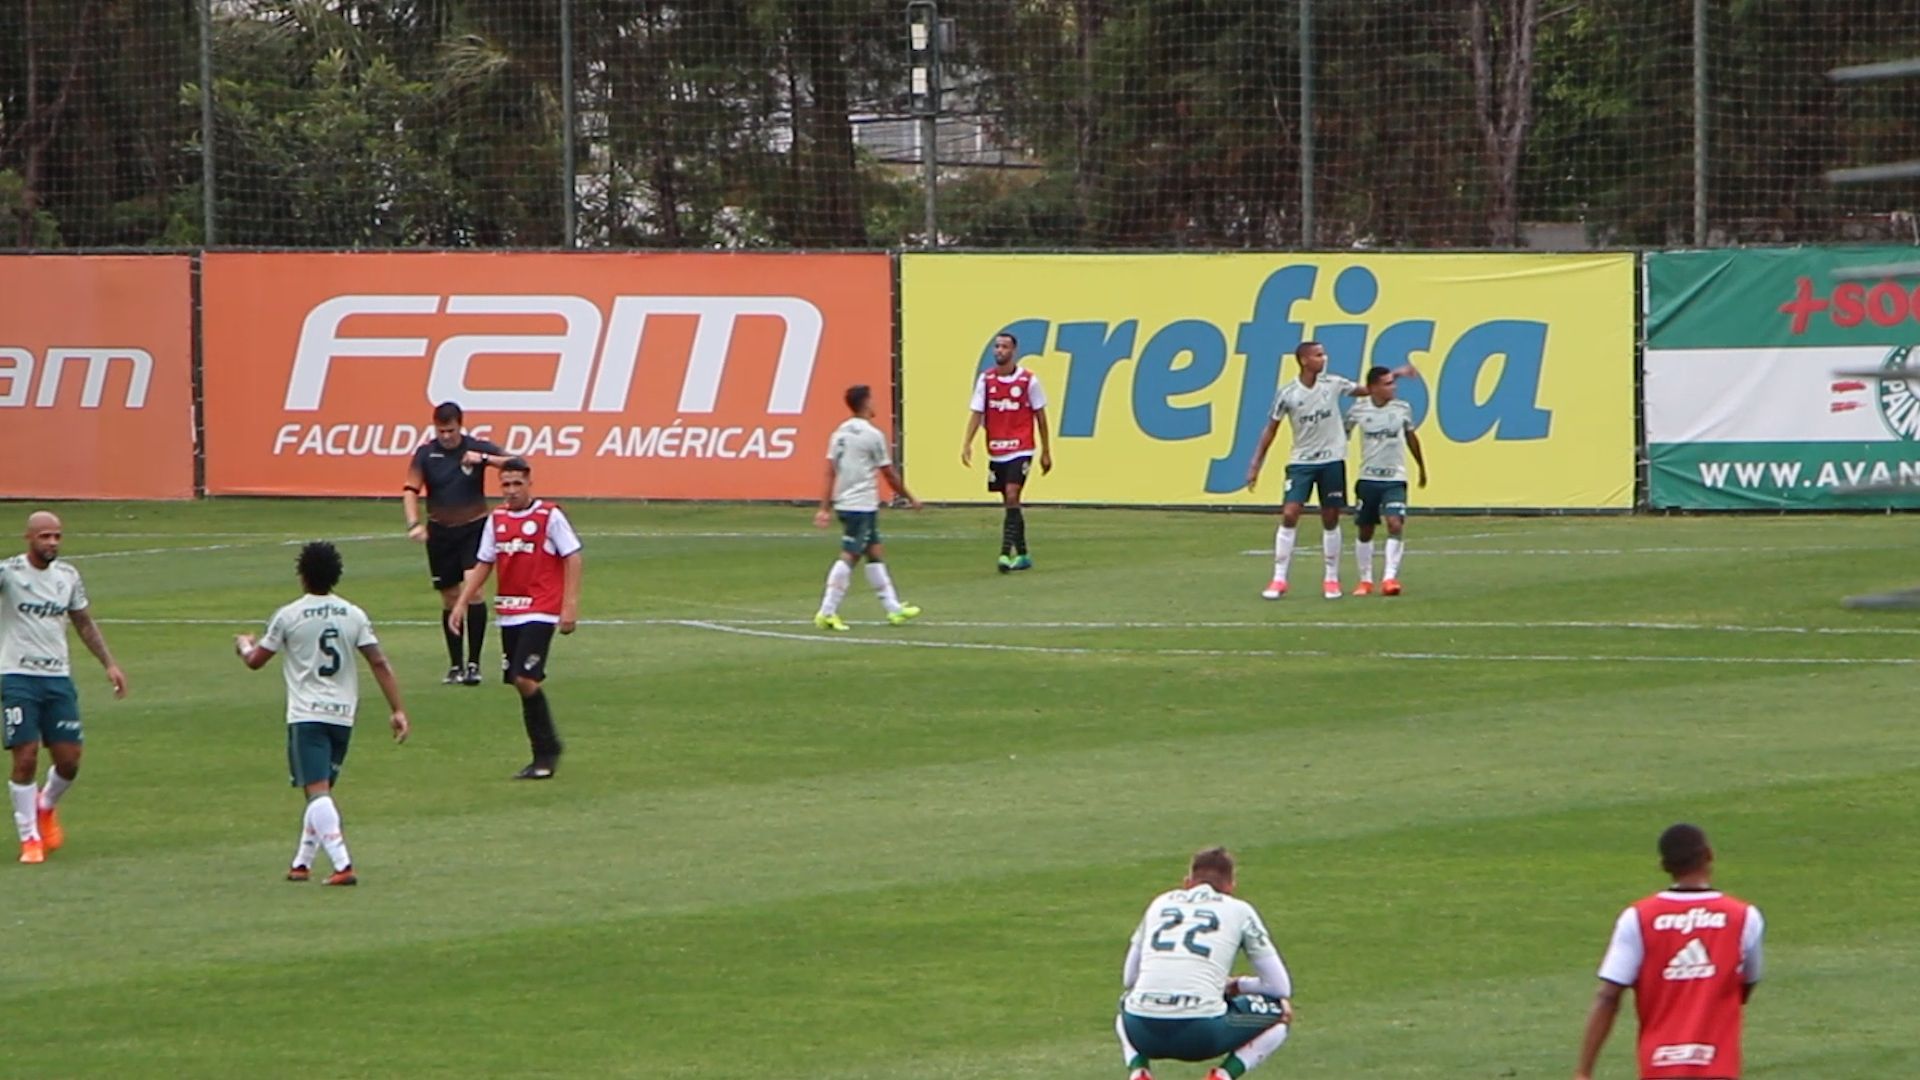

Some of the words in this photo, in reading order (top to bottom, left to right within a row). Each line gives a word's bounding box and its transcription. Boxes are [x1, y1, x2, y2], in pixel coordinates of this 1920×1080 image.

[273, 424, 493, 456] FACULDAE
[505, 425, 584, 457] DAS
[596, 417, 797, 459] AMÉRICAS
[303, 604, 348, 618] crefisa
[319, 628, 341, 677] 5
[4, 706, 23, 725] 30
[1151, 907, 1219, 958] 22
[1653, 907, 1728, 935] crefisa
